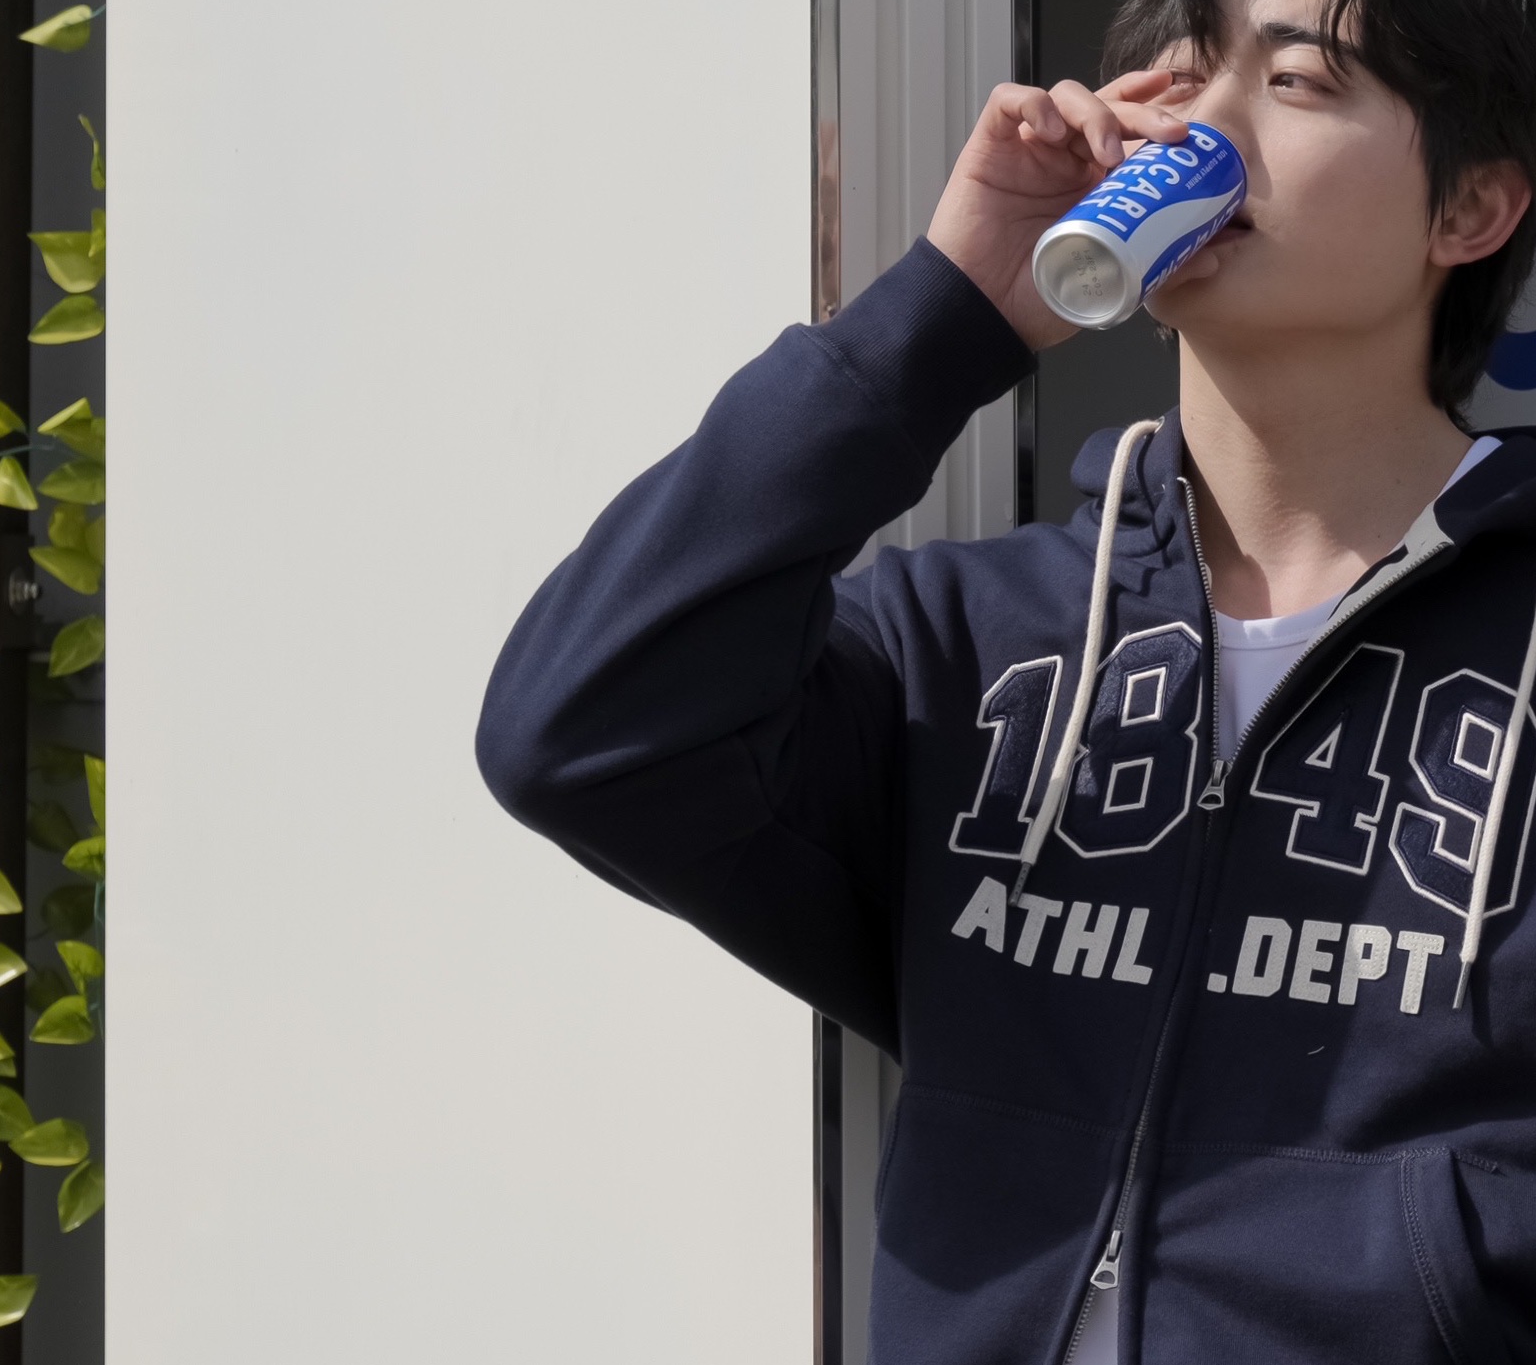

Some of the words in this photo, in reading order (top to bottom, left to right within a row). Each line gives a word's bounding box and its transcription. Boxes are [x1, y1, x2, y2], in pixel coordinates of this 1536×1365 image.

[1079, 143, 1165, 208] WEAT
[1097, 129, 1218, 233] POCARI
[950, 875, 1154, 986] ATHL
